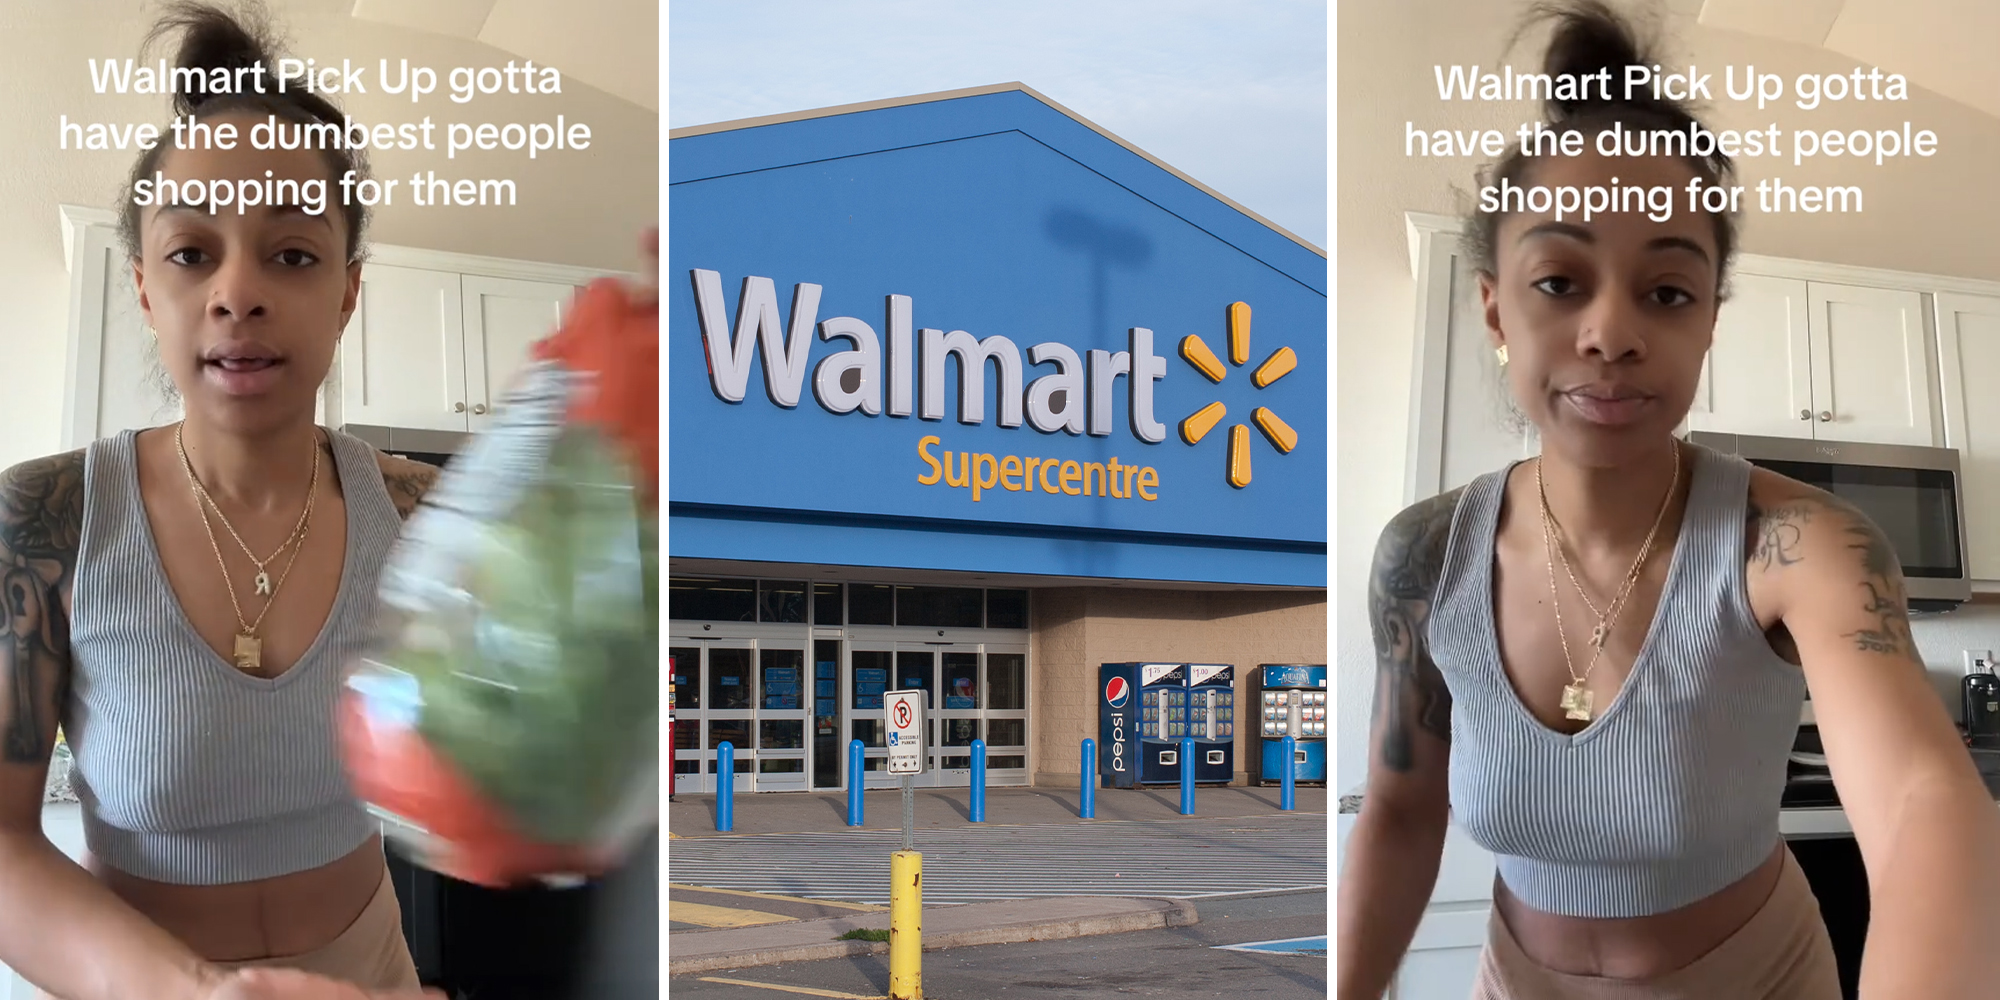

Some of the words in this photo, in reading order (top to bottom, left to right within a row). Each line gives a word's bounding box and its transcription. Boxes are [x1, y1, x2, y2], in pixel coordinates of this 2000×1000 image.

[690, 268, 1167, 444] Walmart
[917, 435, 1159, 502] Supercentre
[1111, 713, 1126, 772] pepsi
